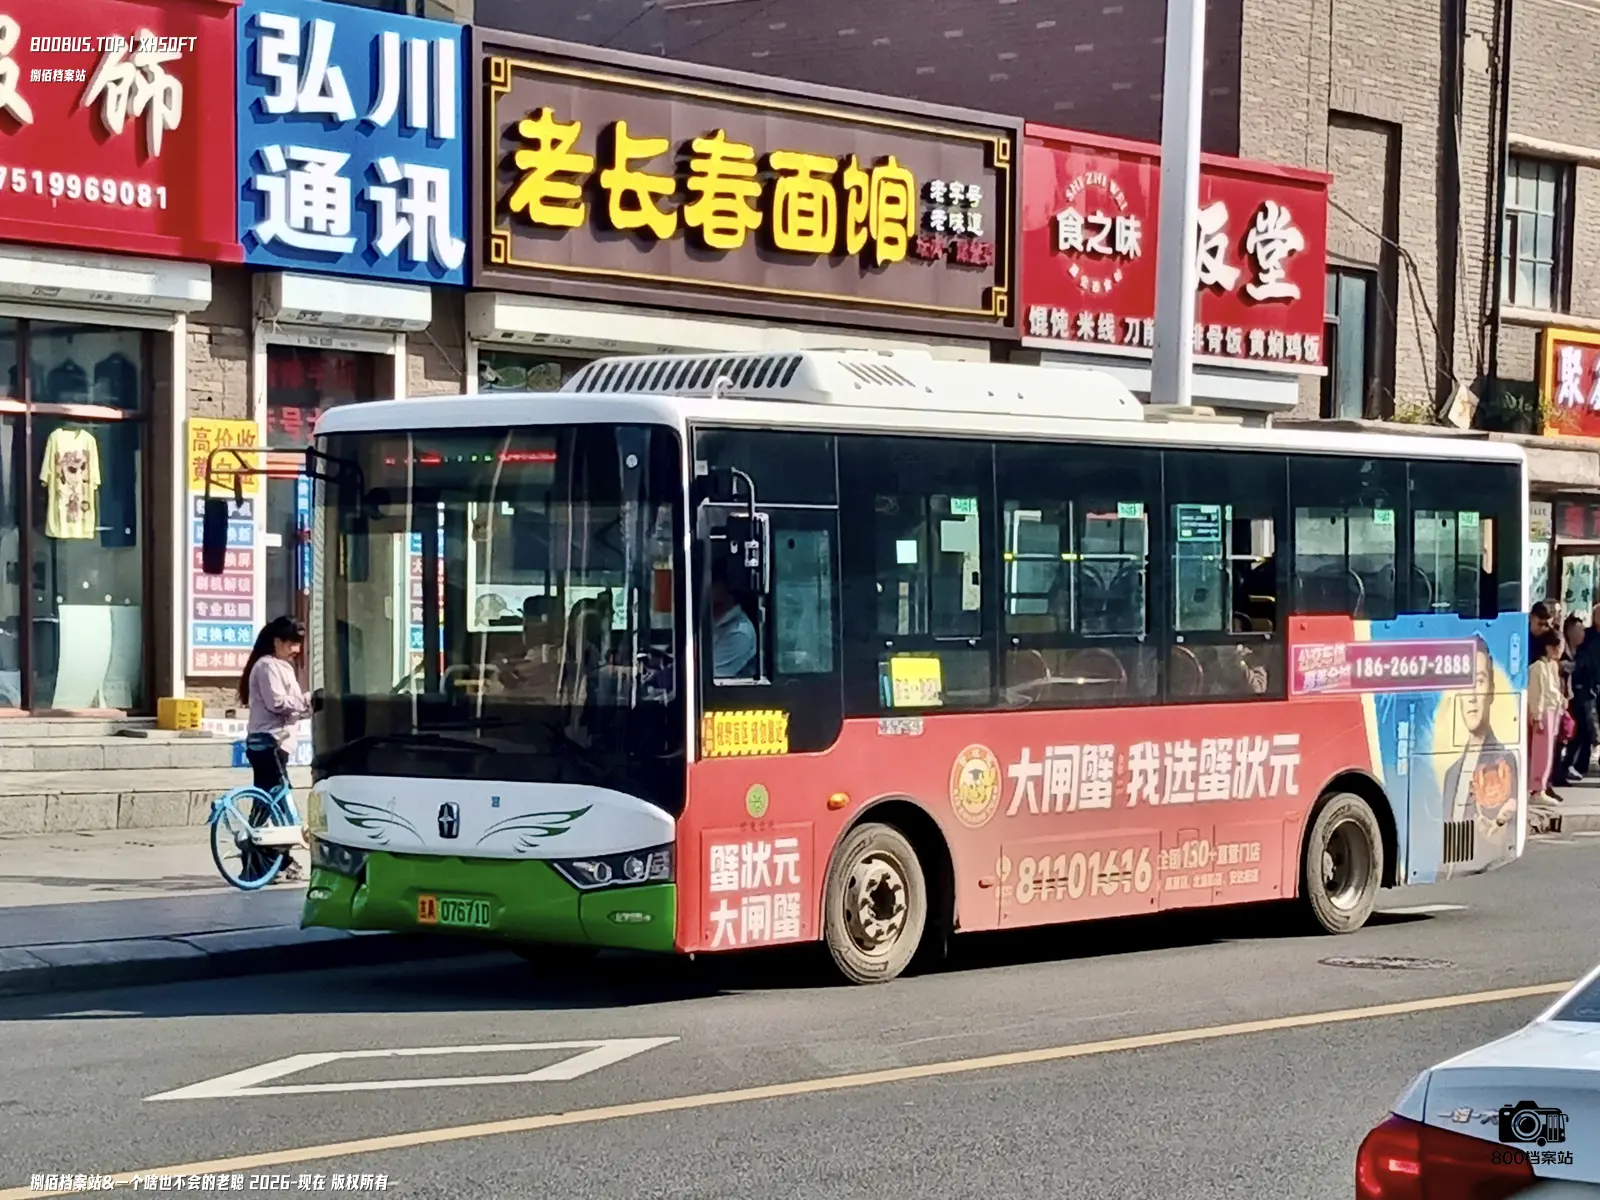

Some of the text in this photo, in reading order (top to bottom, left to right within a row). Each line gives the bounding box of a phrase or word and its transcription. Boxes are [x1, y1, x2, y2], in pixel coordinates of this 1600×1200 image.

[255, 11, 456, 139] 弘川
[251, 144, 466, 270] 通讯
[509, 105, 915, 267] 老长春面馆
[930, 180, 983, 208] 老字号
[1066, 172, 1128, 211] SHI ZHI WEI
[930, 209, 984, 236] 老味道
[1056, 206, 1142, 260] 食之味
[1029, 304, 1069, 337] 馄饨
[1077, 311, 1116, 343] 米线
[192, 426, 256, 453] 高价收
[195, 626, 250, 642] 更换电池
[1356, 654, 1471, 678] 186-2667-2888
[1006, 744, 1116, 817] 大闸蟹
[1127, 733, 1300, 808] 我选蟹状元
[710, 837, 800, 892] 蟹状元
[1016, 847, 1153, 905] 81101616
[441, 900, 490, 925] 07671D
[710, 892, 800, 948] 大闸蟹
